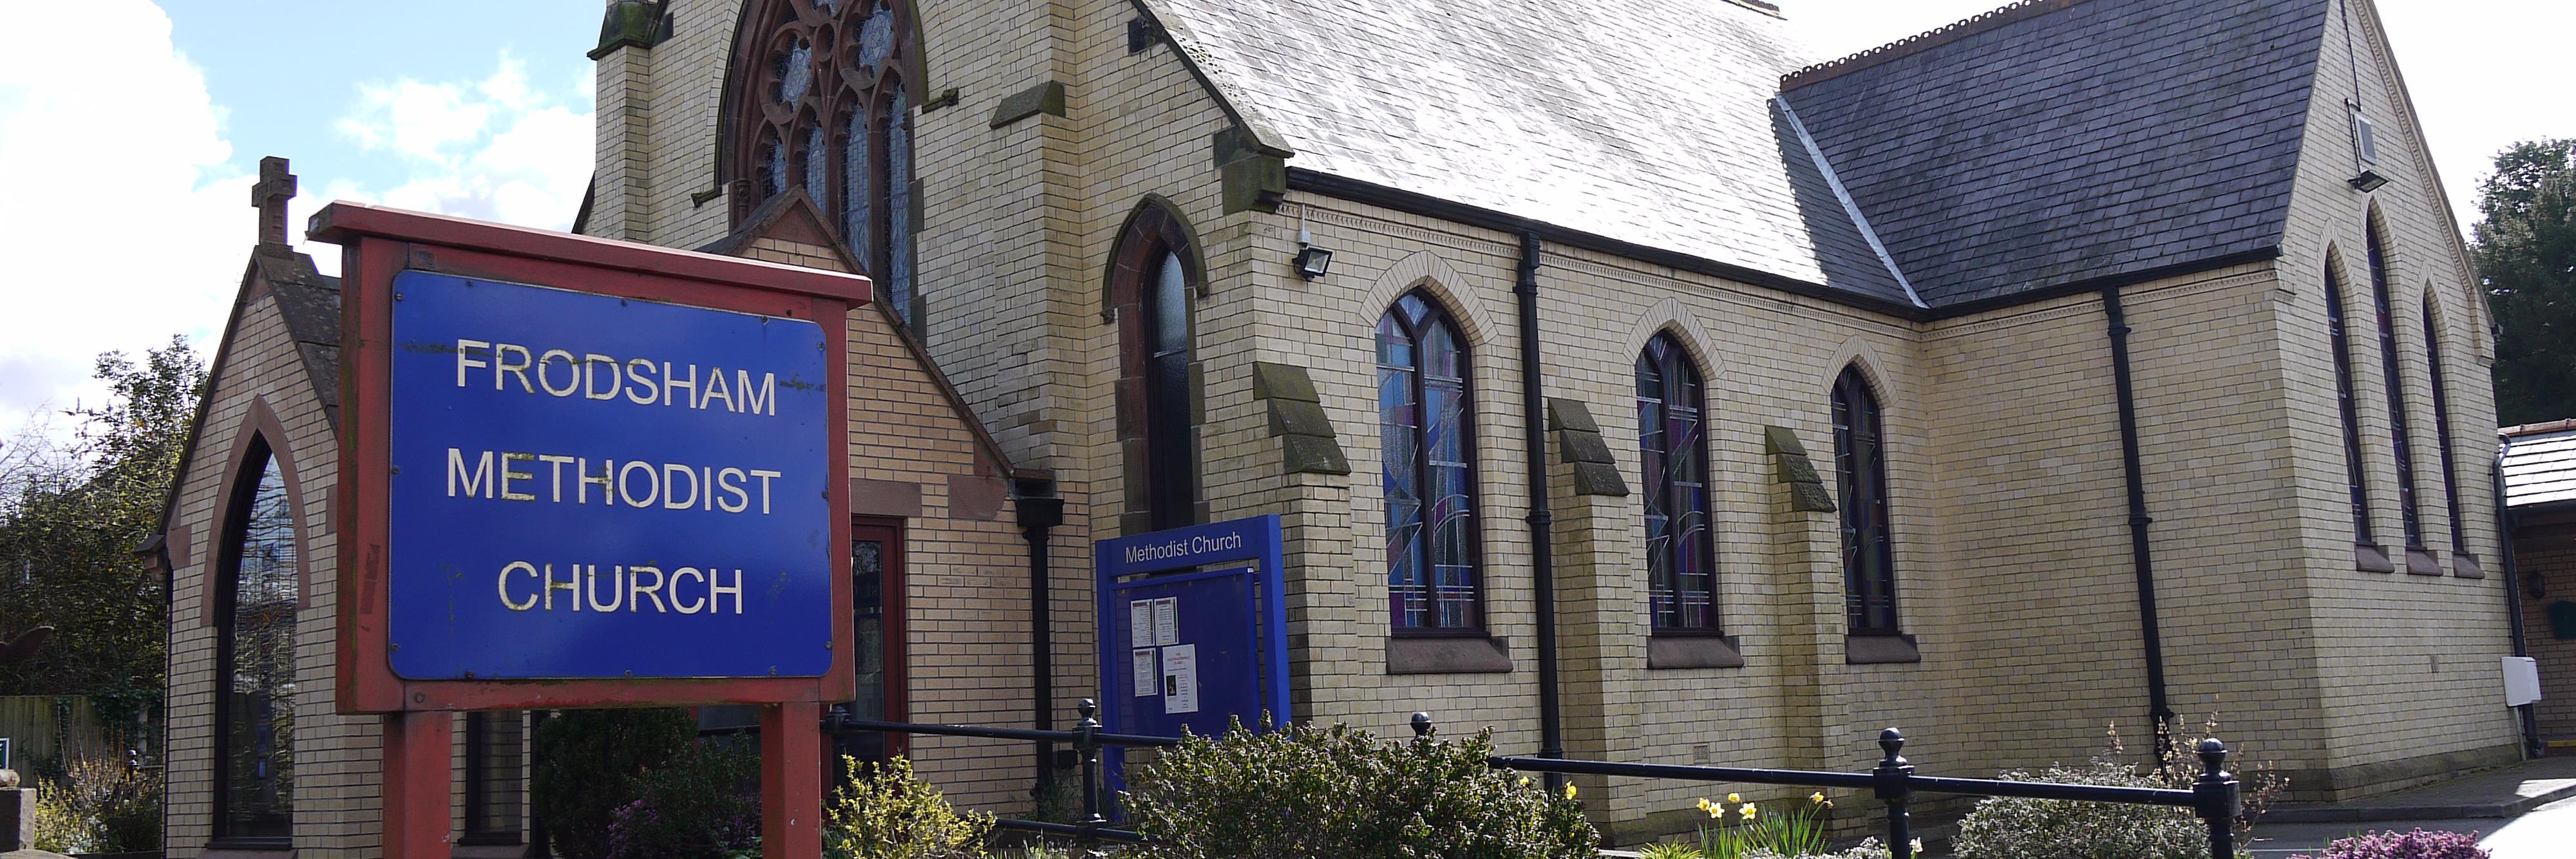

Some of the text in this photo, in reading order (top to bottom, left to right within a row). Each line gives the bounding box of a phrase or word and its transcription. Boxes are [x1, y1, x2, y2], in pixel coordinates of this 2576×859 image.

[458, 339, 775, 417] FRODSHAM
[448, 448, 781, 514] METHODIST
[1126, 531, 1242, 563] Methodist Church
[498, 561, 743, 614] CHURCH
